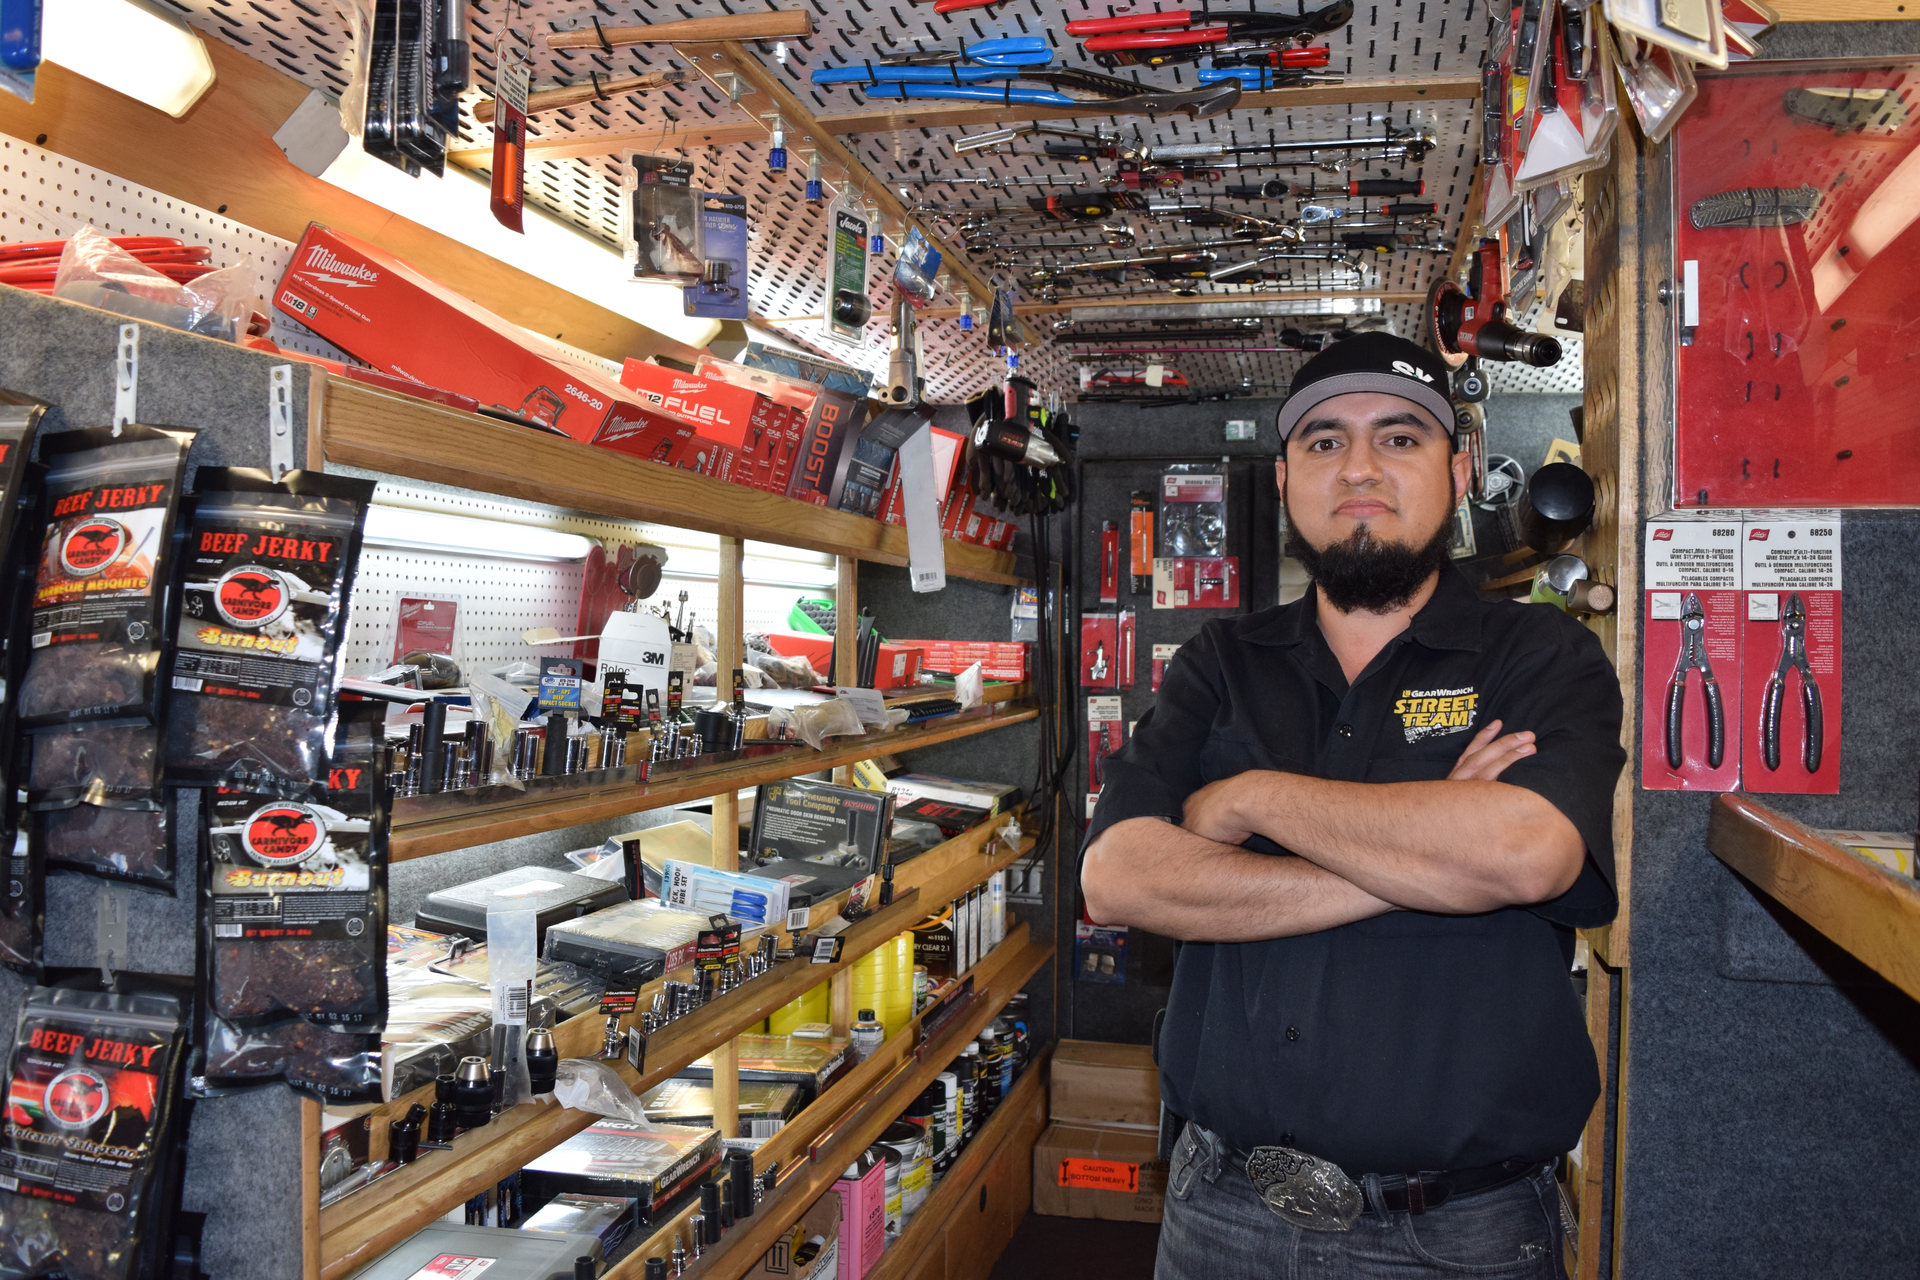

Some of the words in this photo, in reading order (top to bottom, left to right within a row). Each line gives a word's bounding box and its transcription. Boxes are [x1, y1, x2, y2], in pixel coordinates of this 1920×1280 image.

[305, 244, 379, 282] Milwaukee
[282, 294, 306, 311] M18
[344, 303, 361, 318] Grease
[672, 378, 708, 390] Milwaukee
[563, 383, 604, 412] 2646-20
[664, 396, 731, 425] FUEL
[605, 415, 650, 435] Milwaukee
[803, 403, 840, 488] BOOST
[53, 491, 94, 517] BEEF
[94, 484, 165, 509] JERKY
[1712, 529, 1735, 537] 68280
[1809, 528, 1833, 537] 68250
[199, 532, 249, 553] BEEF
[251, 535, 332, 563] JERKY
[74, 556, 102, 565] CANDY
[85, 576, 148, 592] MESQUITE
[223, 598, 272, 610] CARNIVORE
[231, 607, 262, 617] CANDY
[196, 626, 298, 654] Burnout
[641, 651, 665, 665] 3M
[1393, 693, 1479, 714] STREET
[1401, 710, 1469, 728] TEAM
[234, 771, 248, 779] BEST
[251, 773, 261, 781] BY
[785, 796, 801, 806] Tool
[802, 799, 836, 814] Company
[803, 791, 841, 806] Pneumatic
[290, 803, 309, 813] SNACKS
[765, 805, 790, 815] PNEUMATIC
[790, 809, 803, 817] DOOR
[802, 811, 814, 819] SKIN
[813, 813, 836, 823] REMOVER
[835, 817, 847, 825] TOOL
[252, 836, 308, 846] CARNIVORE
[250, 851, 272, 864] PREMIUM
[297, 849, 313, 862] JERKY
[263, 845, 299, 854] CANDY
[224, 867, 345, 888] Burnout
[673, 867, 682, 887] HOOK
[679, 888, 687, 905] RIBE
[328, 1012, 338, 1020] 02
[28, 1028, 85, 1056] BEEF
[84, 1036, 157, 1068] JERKY
[317, 1083, 326, 1092] 02
[342, 1089, 351, 1097] 17
[1082, 1164, 1115, 1173] CAUTION
[1070, 1173, 1100, 1183] BOTTOM
[1102, 1176, 1126, 1185] HEAVY
[653, 1266, 661, 1275] 18
